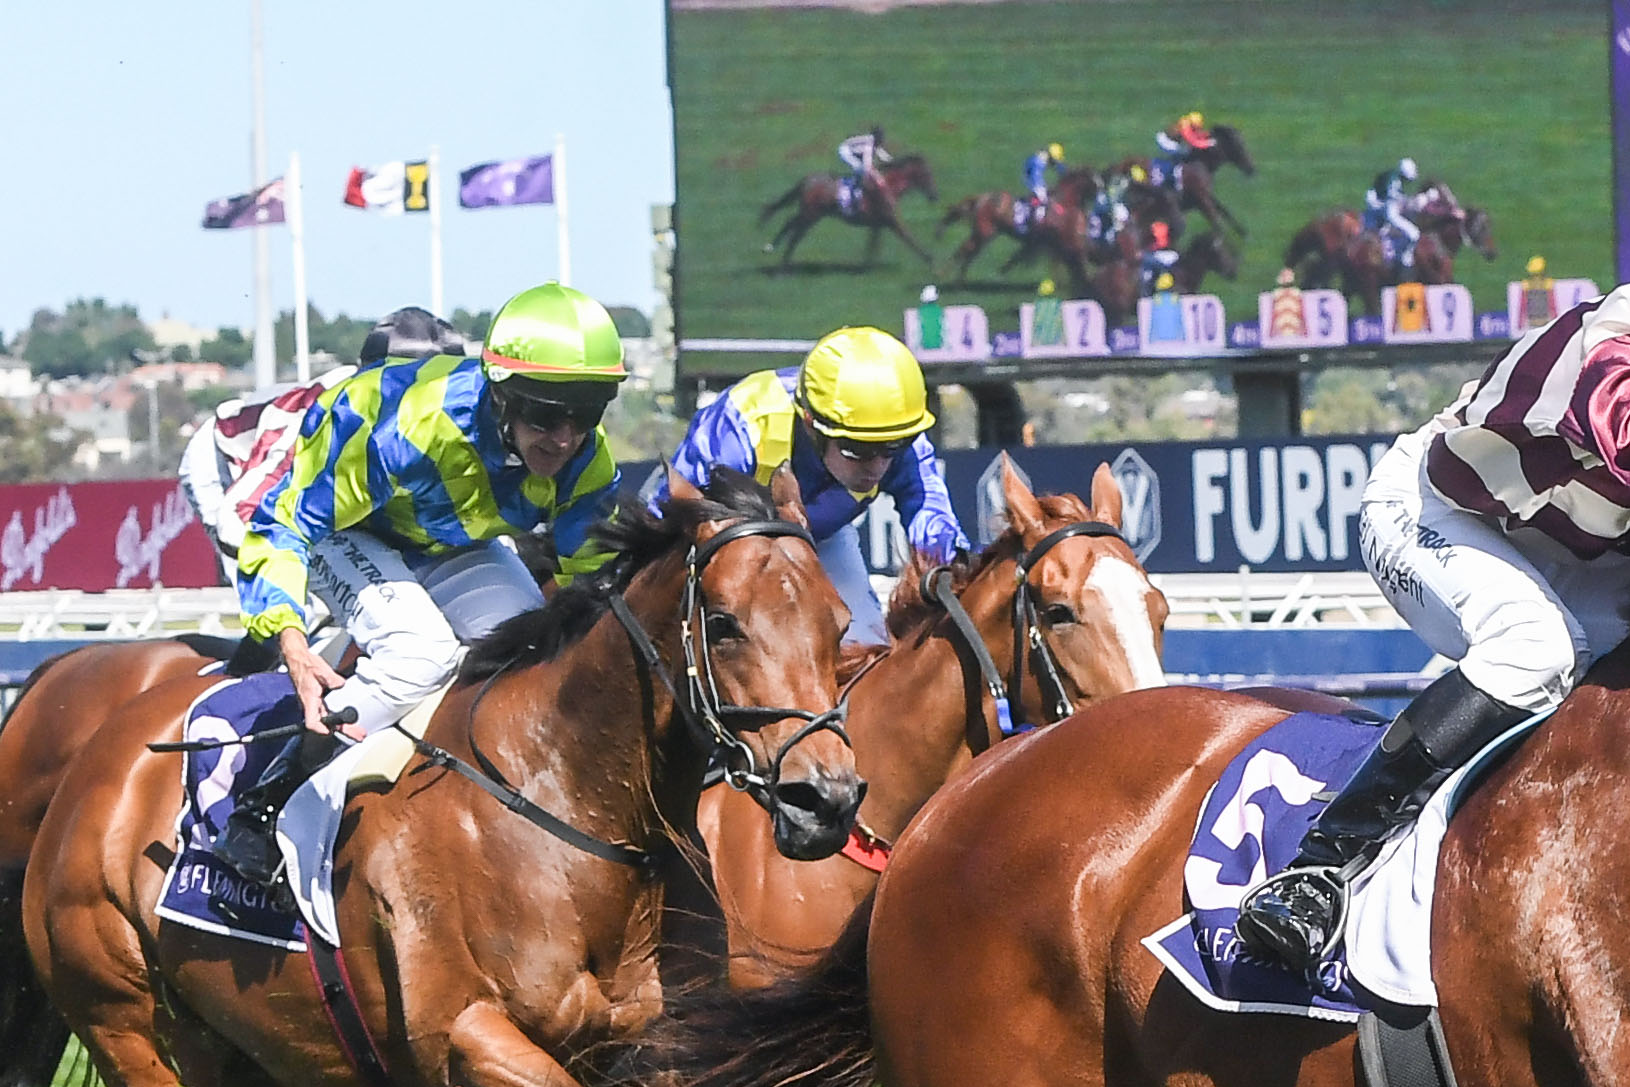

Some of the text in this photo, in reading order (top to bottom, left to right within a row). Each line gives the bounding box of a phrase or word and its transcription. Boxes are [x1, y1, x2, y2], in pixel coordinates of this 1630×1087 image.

[1077, 307, 1090, 348] 2
[1191, 300, 1218, 342] 10
[1316, 297, 1332, 337] 5
[1443, 291, 1457, 332] 9
[1192, 442, 1389, 564] FURP
[1416, 524, 1458, 569] TRACK
[188, 714, 247, 851] 2
[1184, 748, 1328, 911] 5
